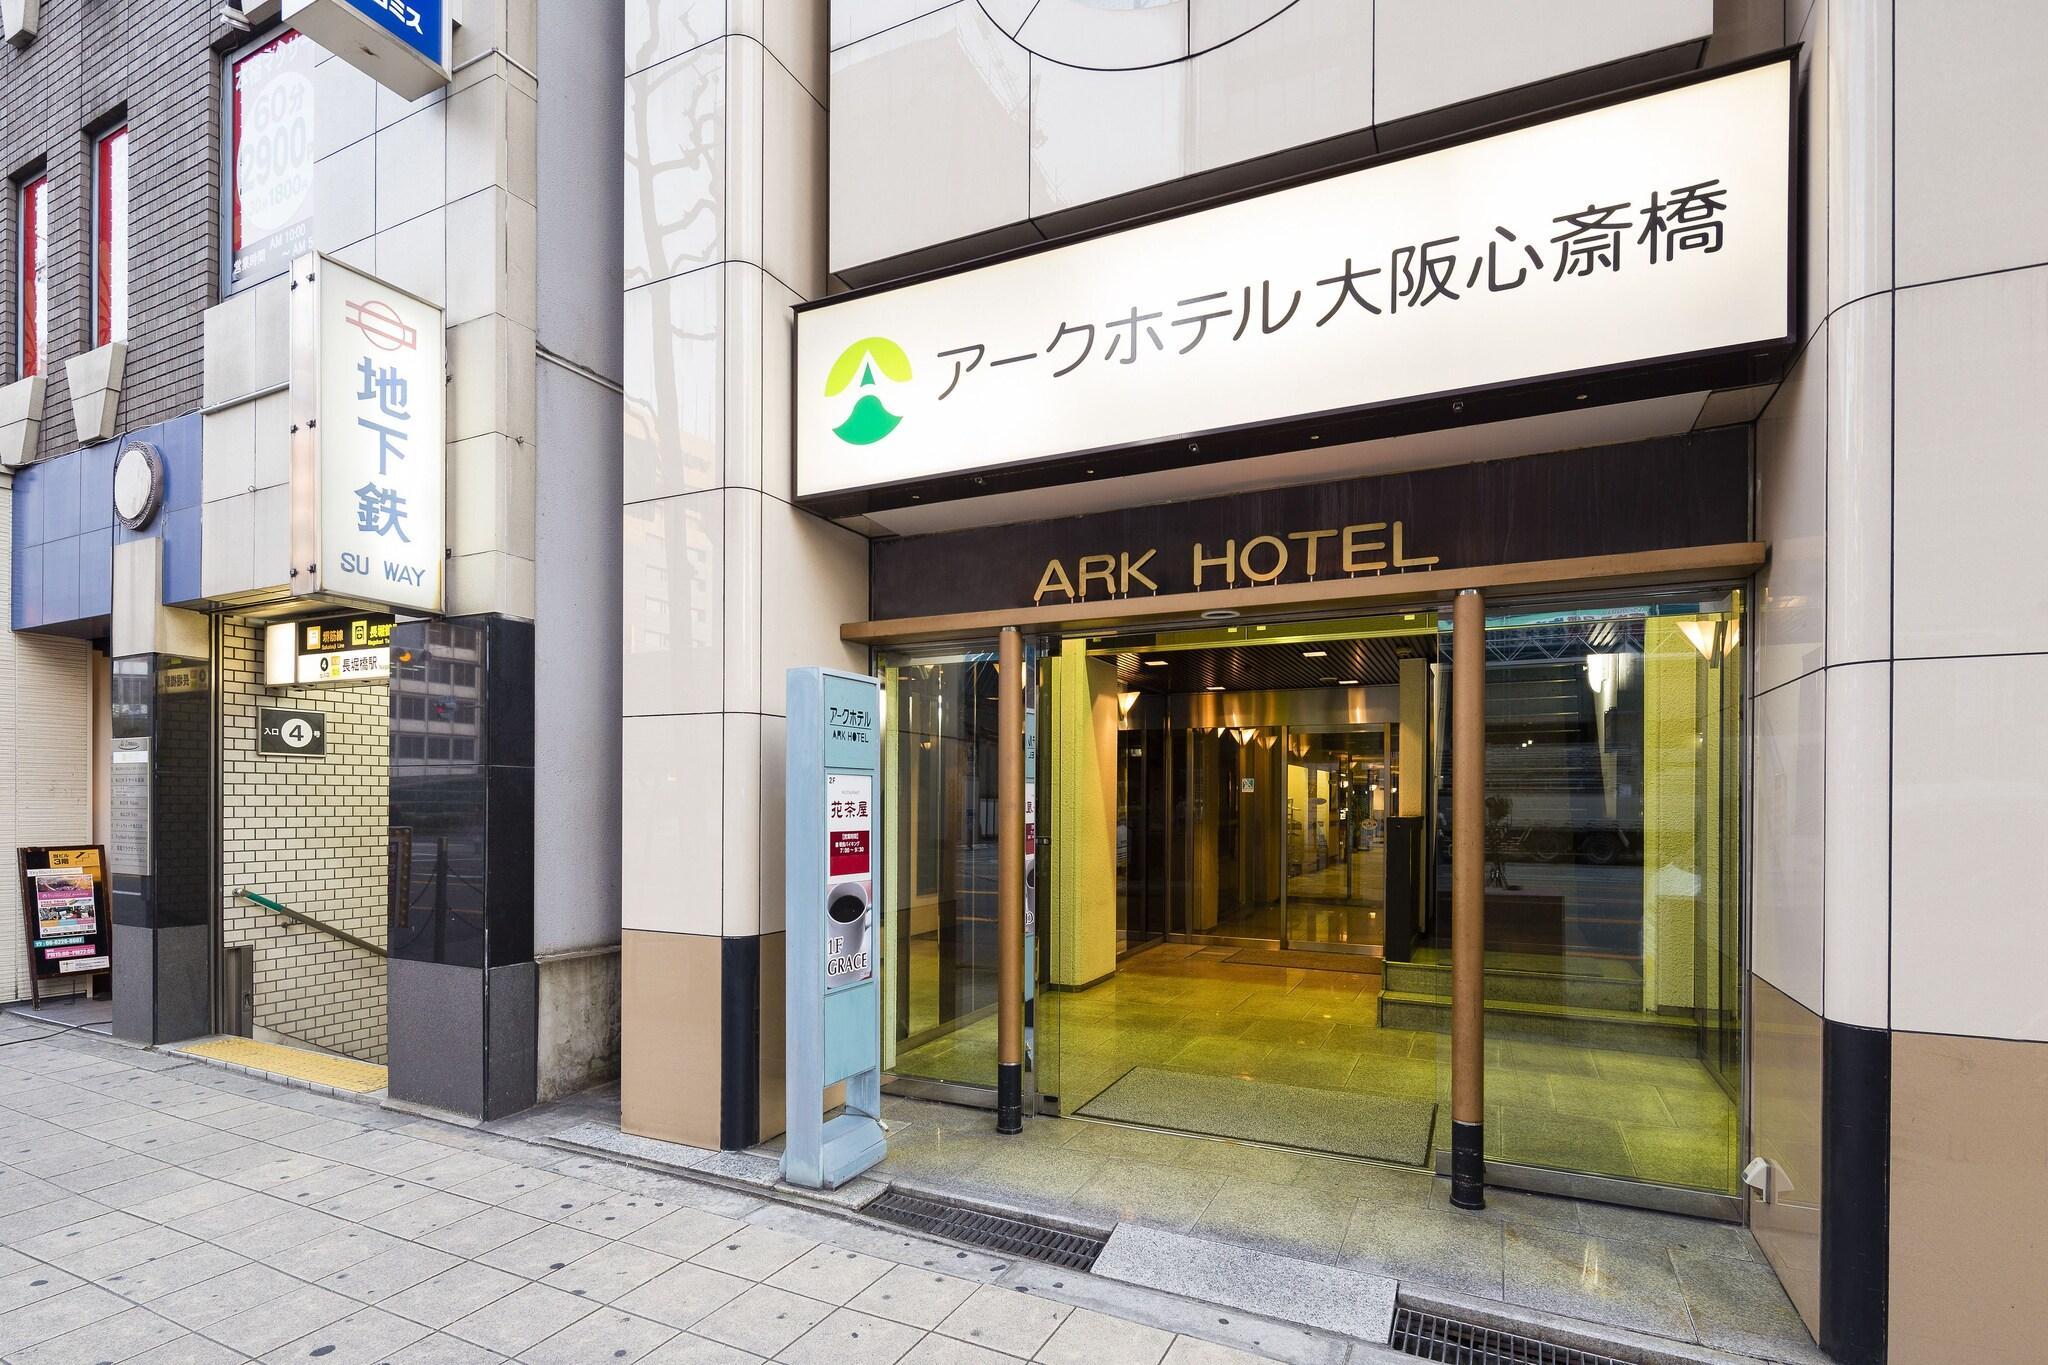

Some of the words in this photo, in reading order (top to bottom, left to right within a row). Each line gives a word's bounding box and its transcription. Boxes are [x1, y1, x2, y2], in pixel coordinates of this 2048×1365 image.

[354, 356, 411, 543] 地下鉄
[1033, 549, 1158, 602] ARK
[1193, 521, 1440, 588] HOTEL
[384, 560, 426, 587] WAY
[343, 656, 377, 672] 長堀橋駅
[830, 707, 871, 727] アークホテル
[263, 727, 279, 736] 入口
[289, 725, 304, 742] 4
[832, 730, 845, 741] ARK
[848, 731, 869, 743] HOTEL
[831, 801, 868, 818] 花茶屋
[829, 937, 843, 955] 1F
[828, 952, 867, 976] GRACE
